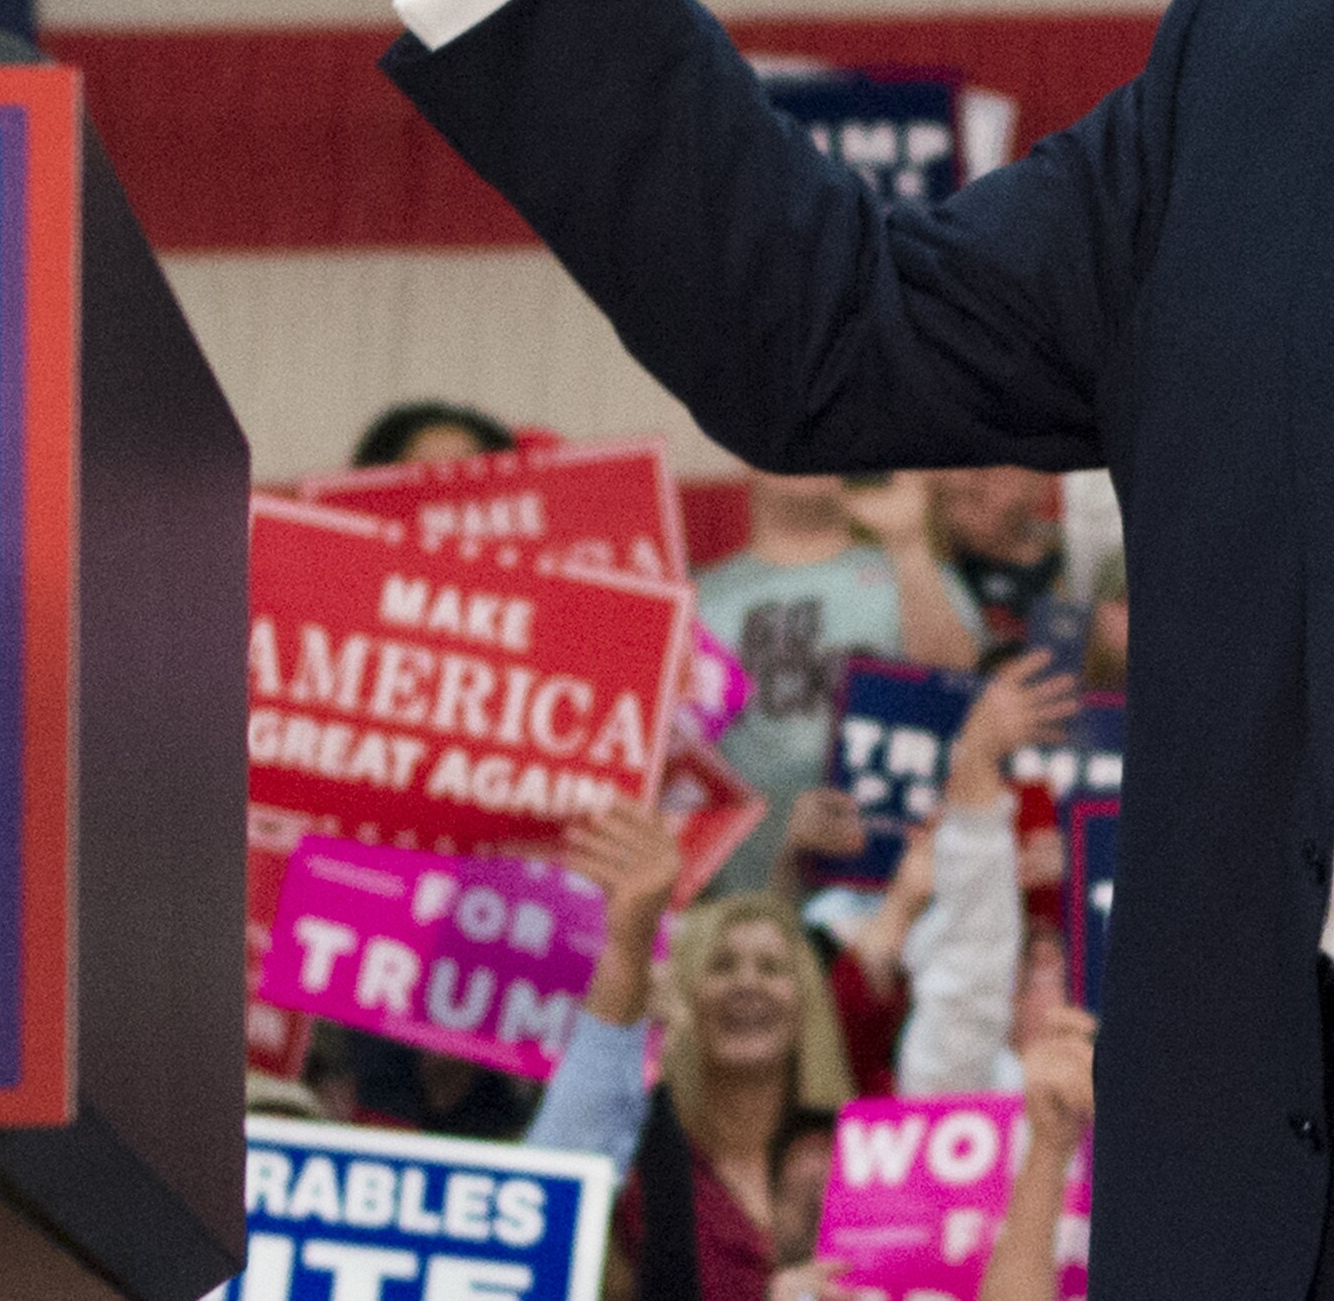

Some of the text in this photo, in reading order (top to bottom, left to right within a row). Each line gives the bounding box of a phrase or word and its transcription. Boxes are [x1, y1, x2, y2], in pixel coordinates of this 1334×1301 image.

[381, 571, 534, 652] MAKE
[247, 618, 647, 770] AMERICA
[247, 710, 424, 790] GREAT
[411, 870, 555, 958] FOR
[246, 1150, 547, 1247] RABLES
